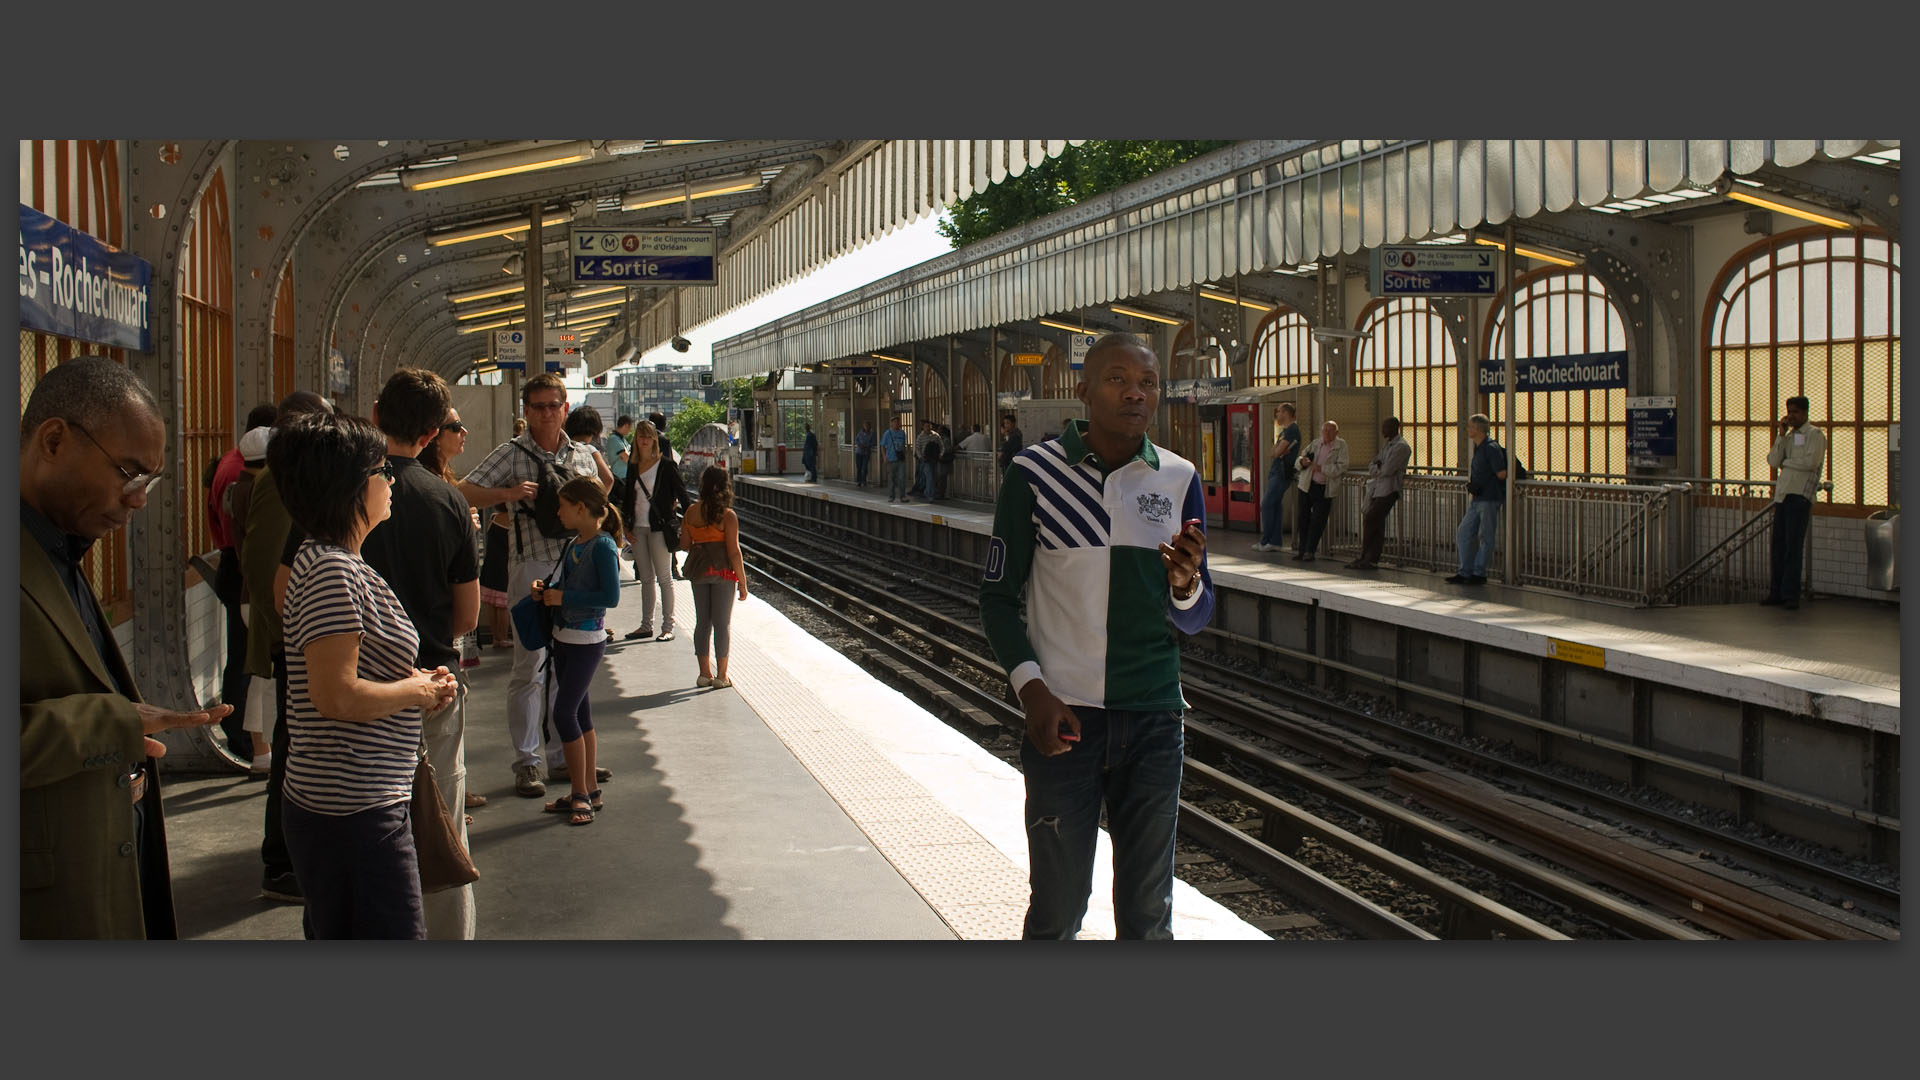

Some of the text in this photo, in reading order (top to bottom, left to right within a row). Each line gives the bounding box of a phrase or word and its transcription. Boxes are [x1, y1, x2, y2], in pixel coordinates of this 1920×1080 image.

[653, 235, 663, 243] de
[664, 235, 710, 244] Clignancourt
[653, 243, 688, 251] d'Orléans
[601, 259, 659, 276] Sortie
[52, 245, 148, 329] Rochechouart
[1384, 273, 1431, 289] Sortie
[1529, 360, 1621, 384] Rochechouart
